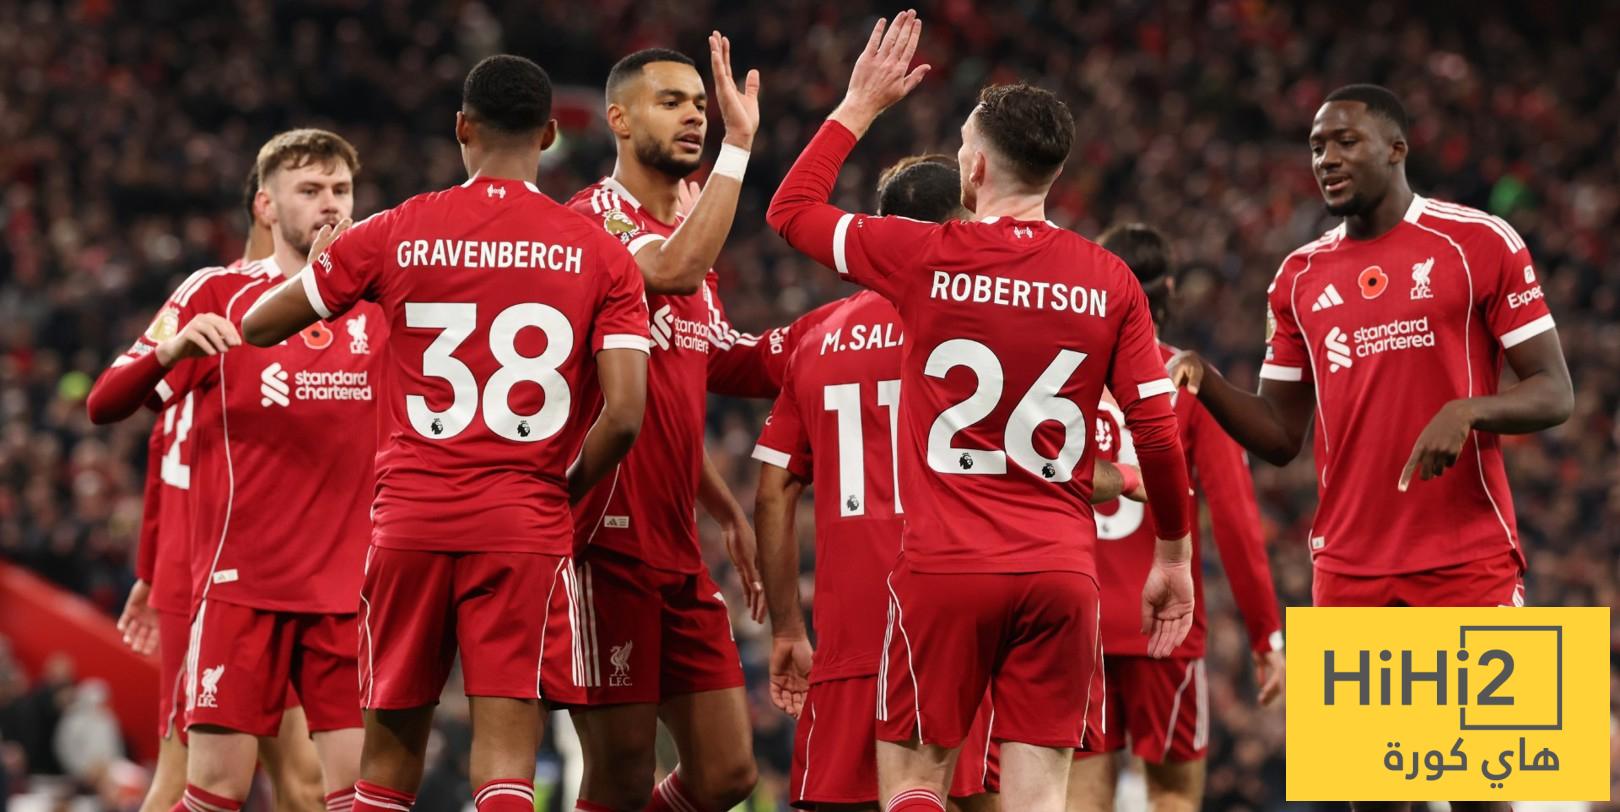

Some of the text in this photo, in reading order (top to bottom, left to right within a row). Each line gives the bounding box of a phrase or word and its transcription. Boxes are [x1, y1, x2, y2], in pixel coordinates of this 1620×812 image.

[318, 252, 332, 274] dia
[396, 239, 582, 274] GRAVENBERCH
[930, 270, 1107, 318] ROBERTSON
[769, 328, 784, 355] dia
[1353, 316, 1429, 343] standard
[1356, 331, 1435, 357] chartered
[295, 369, 368, 386] standard
[404, 302, 574, 442] 38
[295, 383, 372, 401] chartered
[923, 338, 1089, 483] 26
